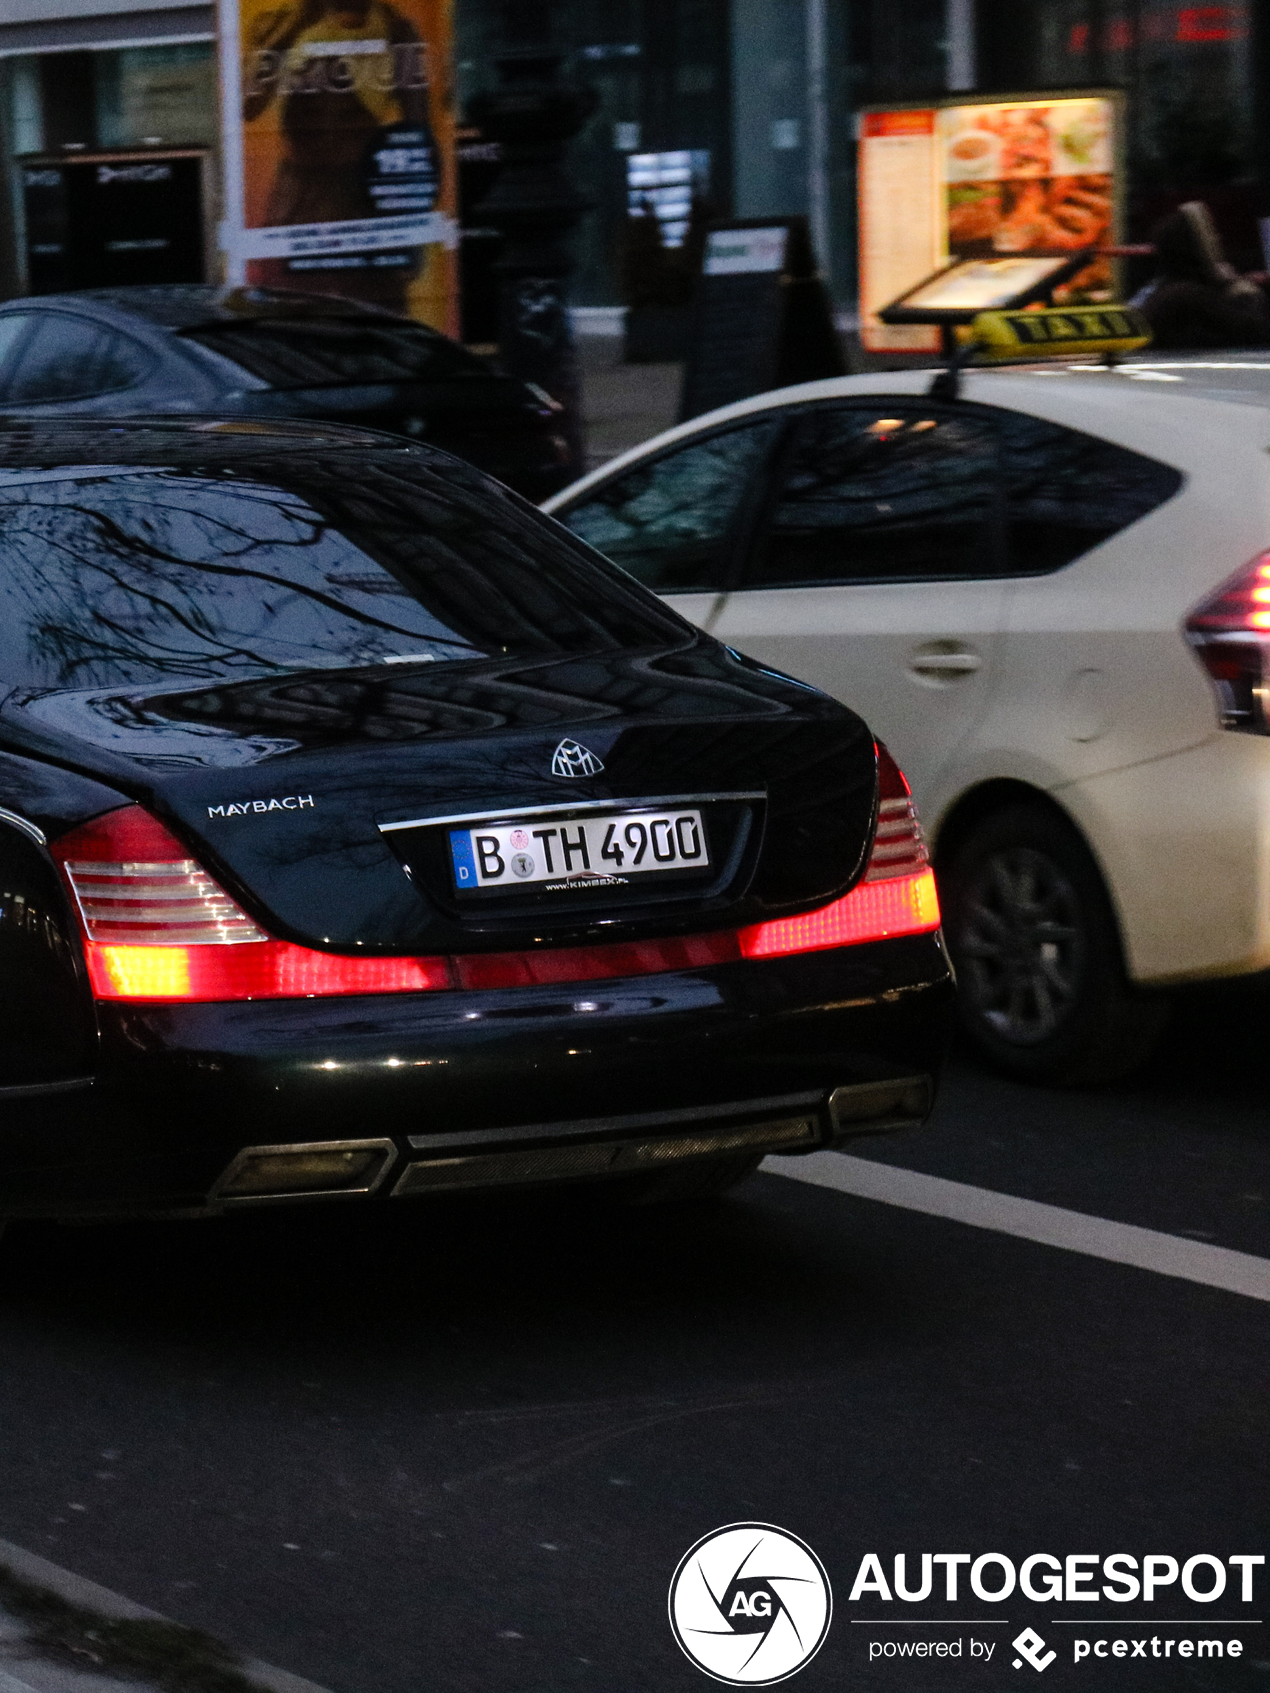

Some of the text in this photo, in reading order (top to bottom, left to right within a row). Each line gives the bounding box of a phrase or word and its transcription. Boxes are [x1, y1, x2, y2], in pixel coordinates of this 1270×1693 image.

[1016, 311, 1131, 341] TAXI
[207, 795, 315, 818] MAYBACH
[475, 816, 702, 879] B TH 4900
